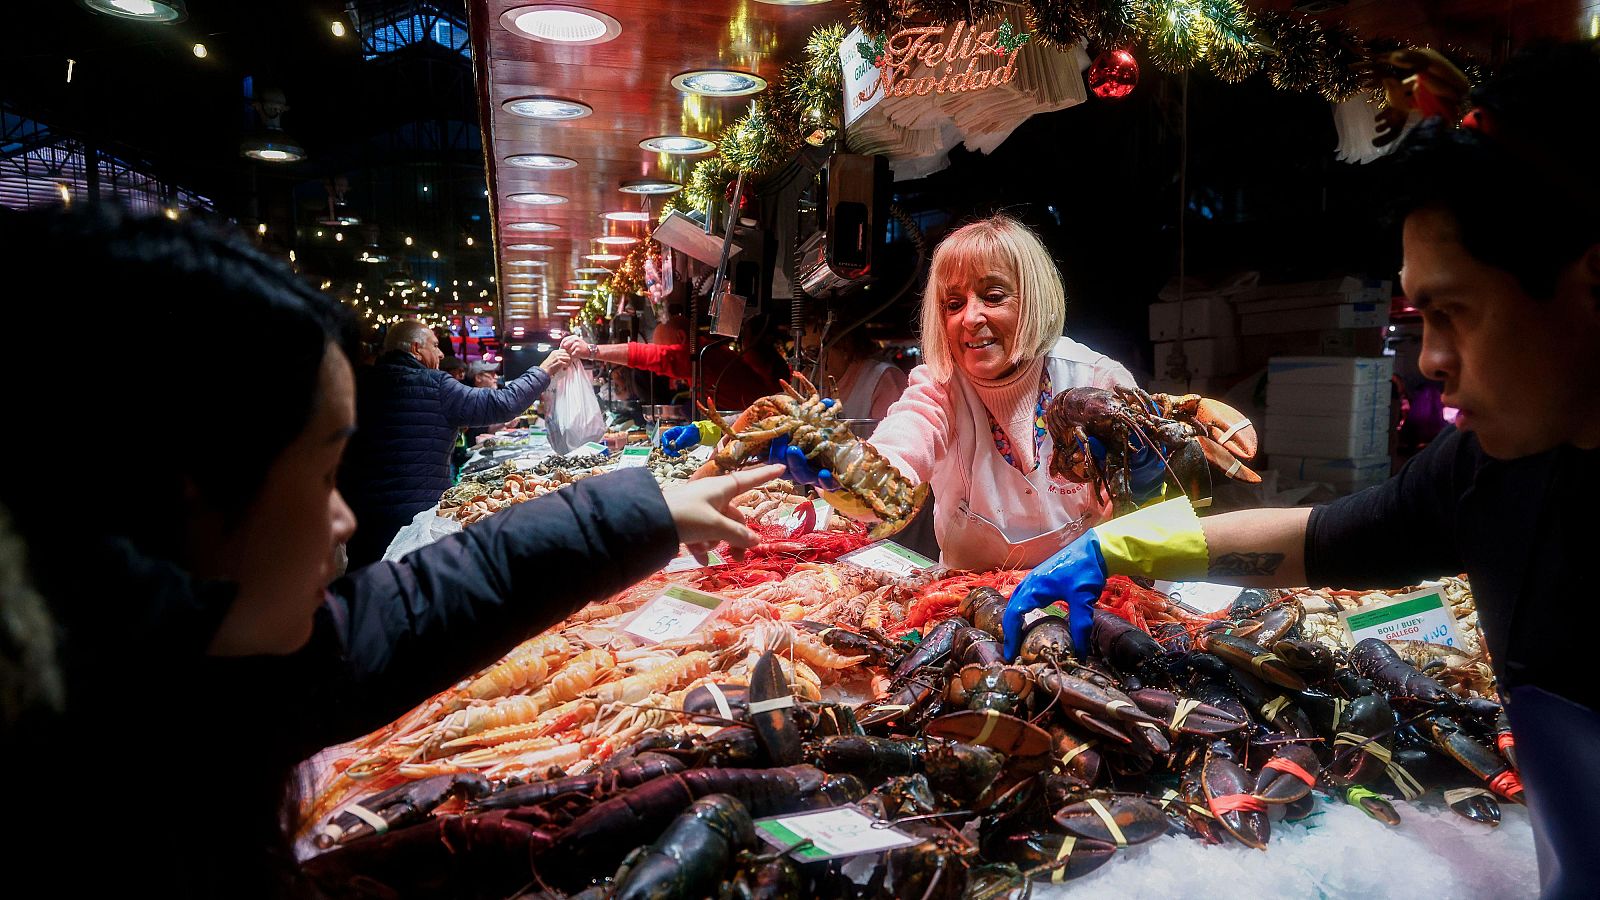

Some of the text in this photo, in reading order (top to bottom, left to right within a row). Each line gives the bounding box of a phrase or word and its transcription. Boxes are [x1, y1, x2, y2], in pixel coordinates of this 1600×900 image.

[886, 20, 998, 68] Feliz
[859, 44, 1022, 101] Navidad
[1377, 625, 1395, 635] BOU
[1401, 617, 1422, 629] BUEY
[1385, 626, 1420, 640] GALLEGO
